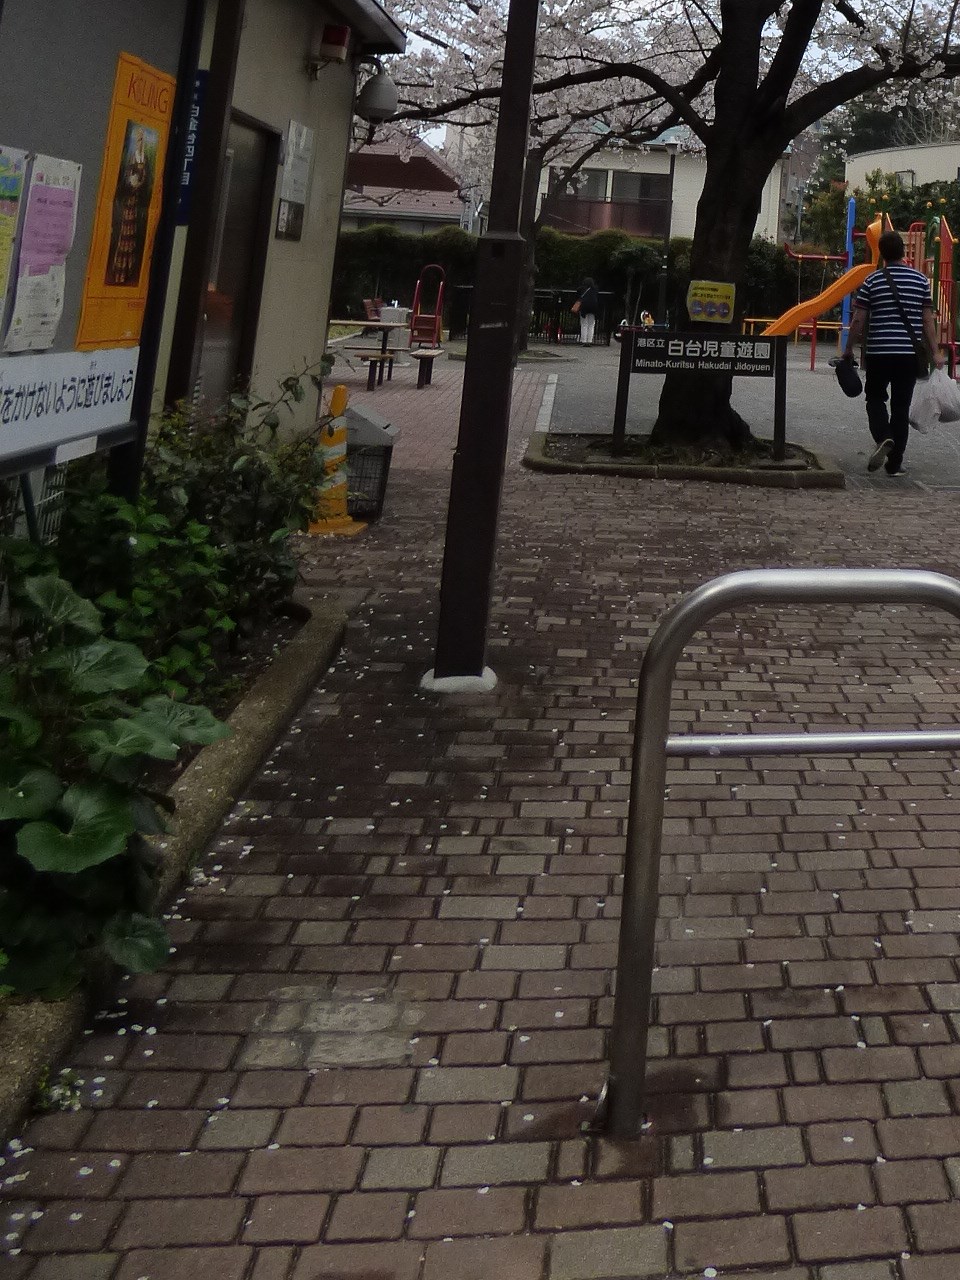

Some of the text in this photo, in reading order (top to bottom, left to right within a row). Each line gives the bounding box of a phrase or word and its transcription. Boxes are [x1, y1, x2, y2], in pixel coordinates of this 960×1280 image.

[637, 338, 770, 359] 港区立 白台児童遊園
[635, 359, 771, 372] Minato-Kuritsu Hakudai Jidoyuen
